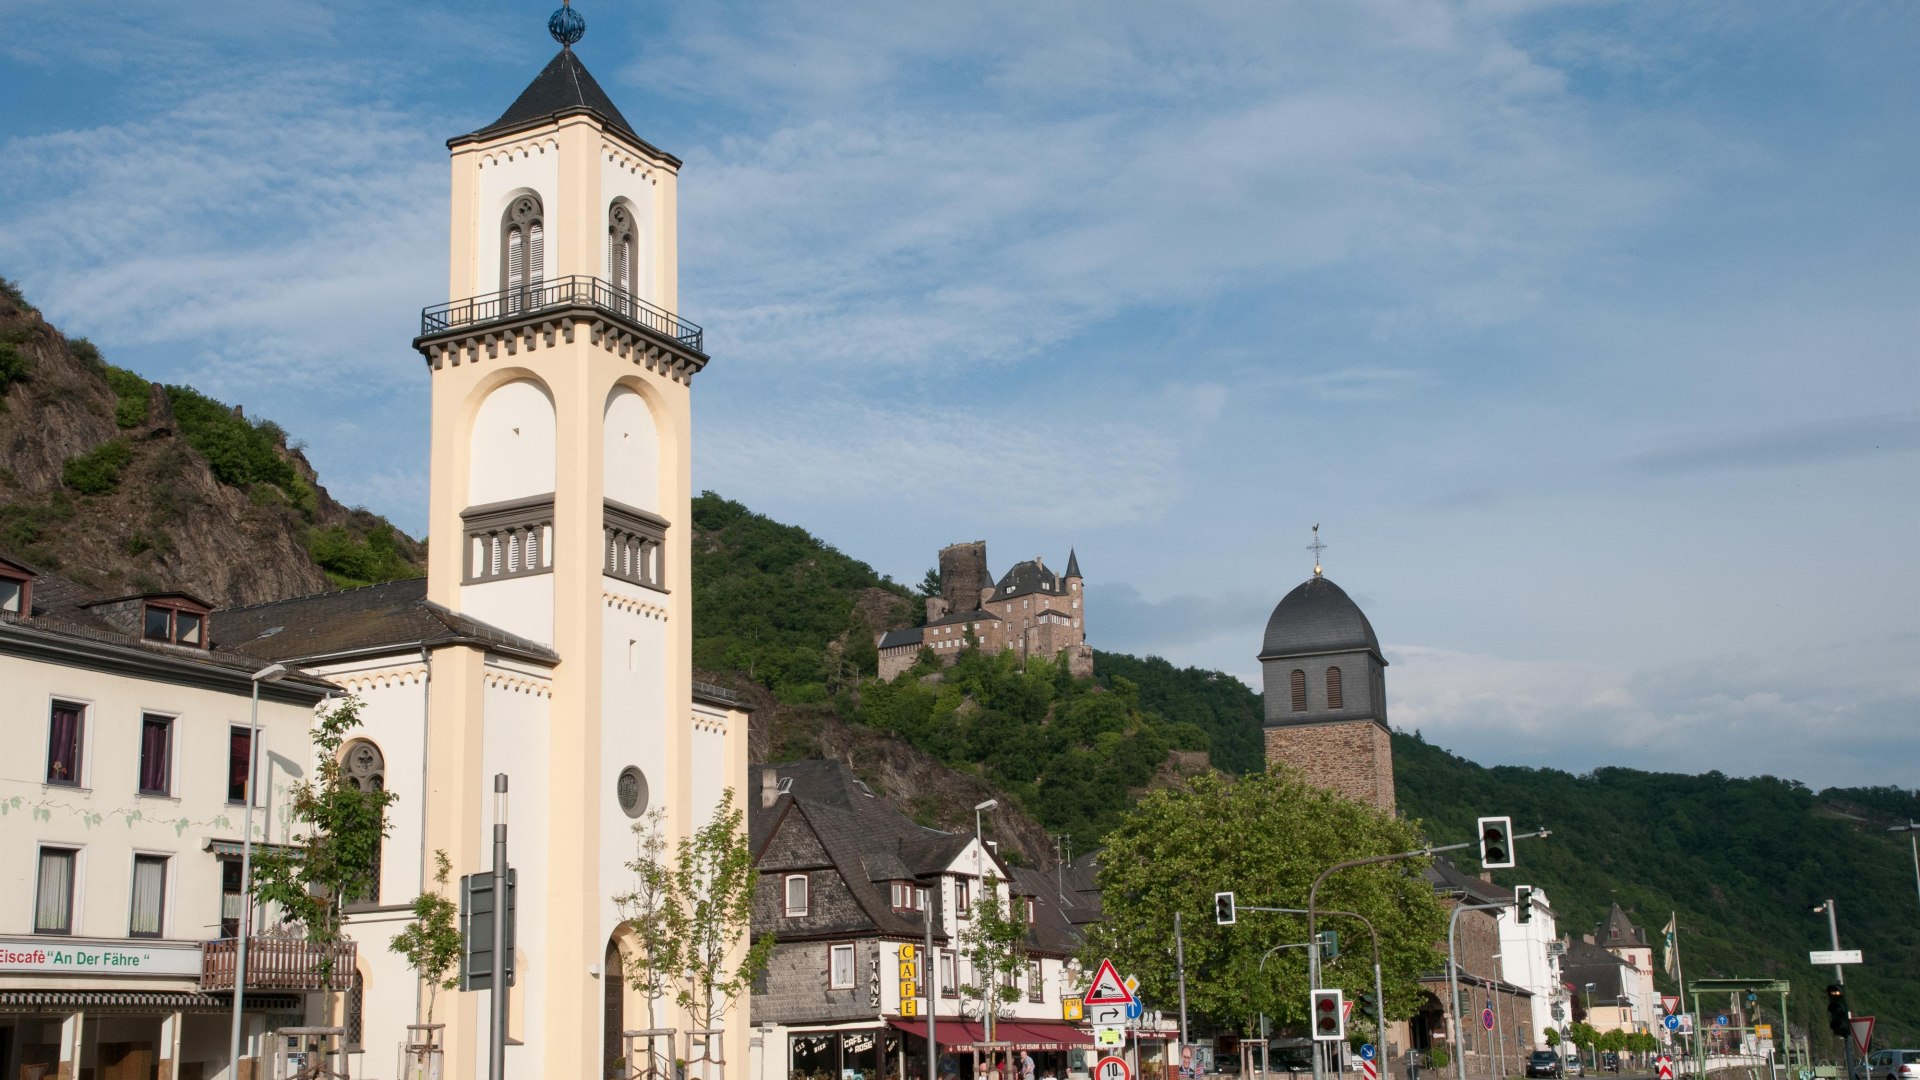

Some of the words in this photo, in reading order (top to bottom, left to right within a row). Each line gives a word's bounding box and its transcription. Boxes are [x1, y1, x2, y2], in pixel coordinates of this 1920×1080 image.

[76, 951, 100, 965] Der
[103, 952, 140, 966] Fähre
[869, 960, 879, 1008] TANZ
[902, 945, 912, 1014] CAFE
[794, 1041, 806, 1053] EIS
[843, 1035, 863, 1048] CAFE
[854, 1041, 873, 1053] ROSE
[1106, 1063, 1118, 1077] 10
